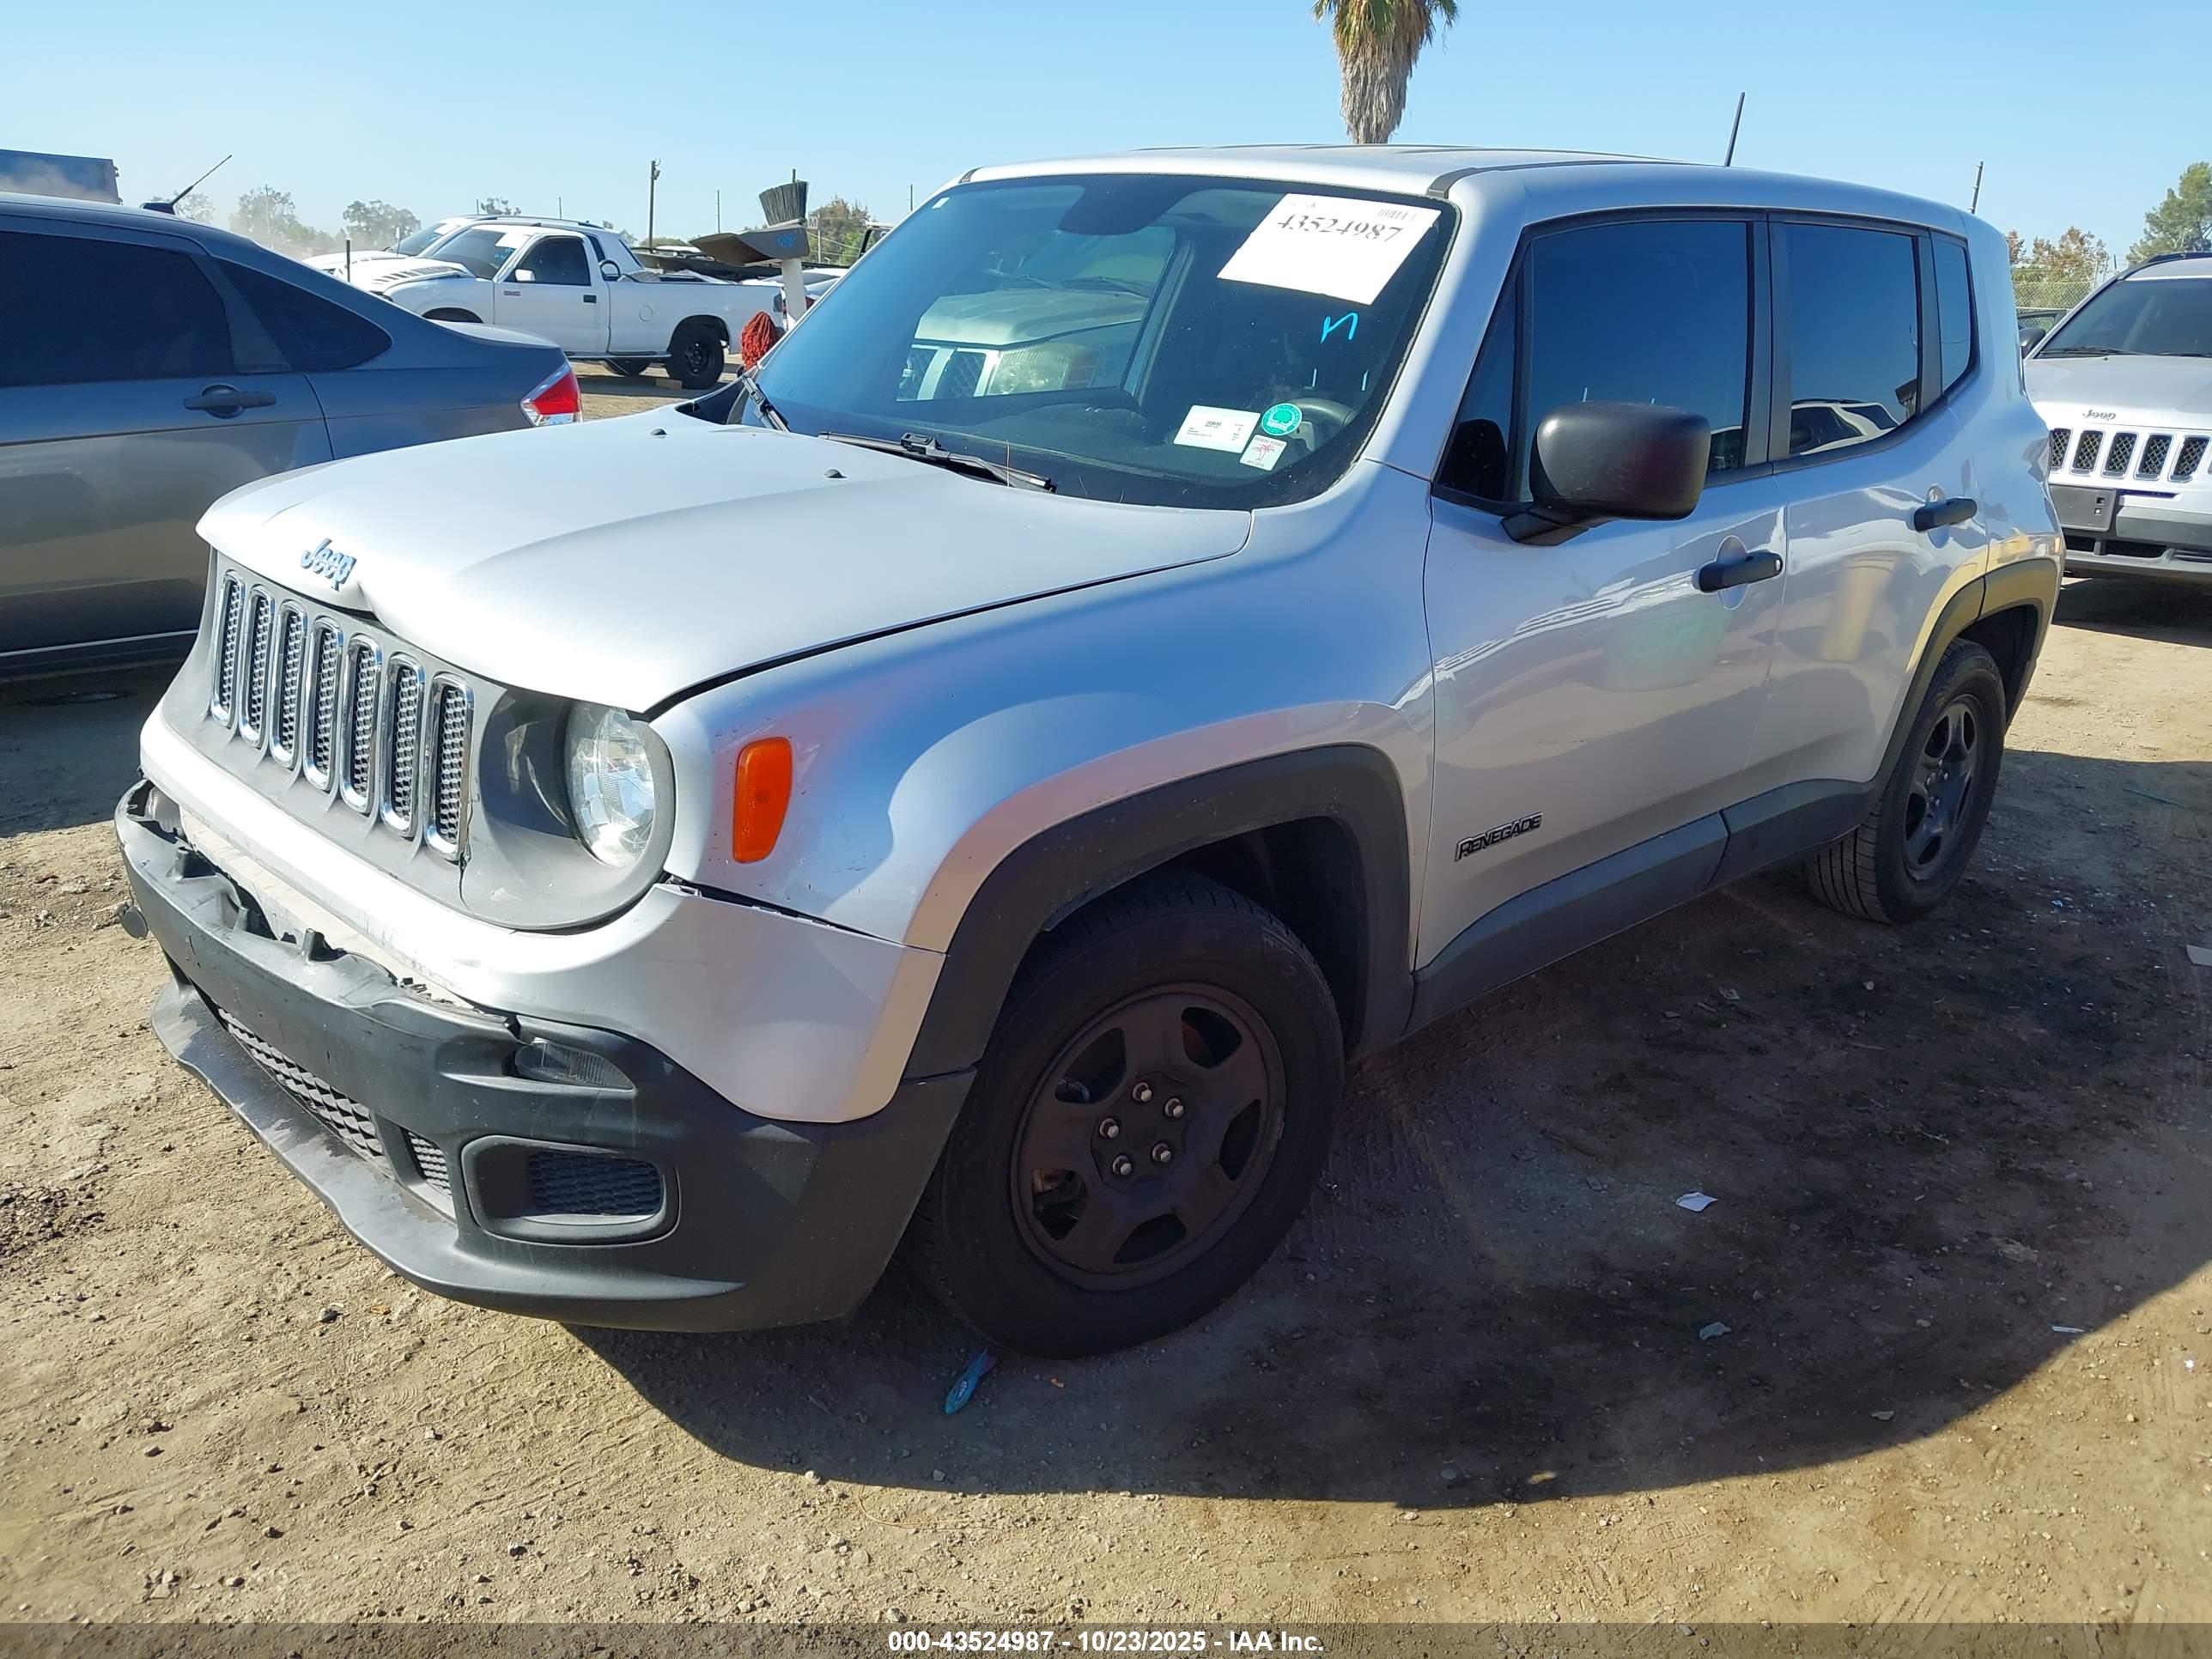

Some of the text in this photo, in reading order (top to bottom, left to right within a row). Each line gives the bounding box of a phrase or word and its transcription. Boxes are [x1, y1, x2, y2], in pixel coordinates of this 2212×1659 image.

[1279, 214, 1402, 241] 43524987
[2081, 409, 2117, 421] Jeep
[301, 538, 357, 592] Jeep
[1454, 811, 1544, 862] RENEGADE
